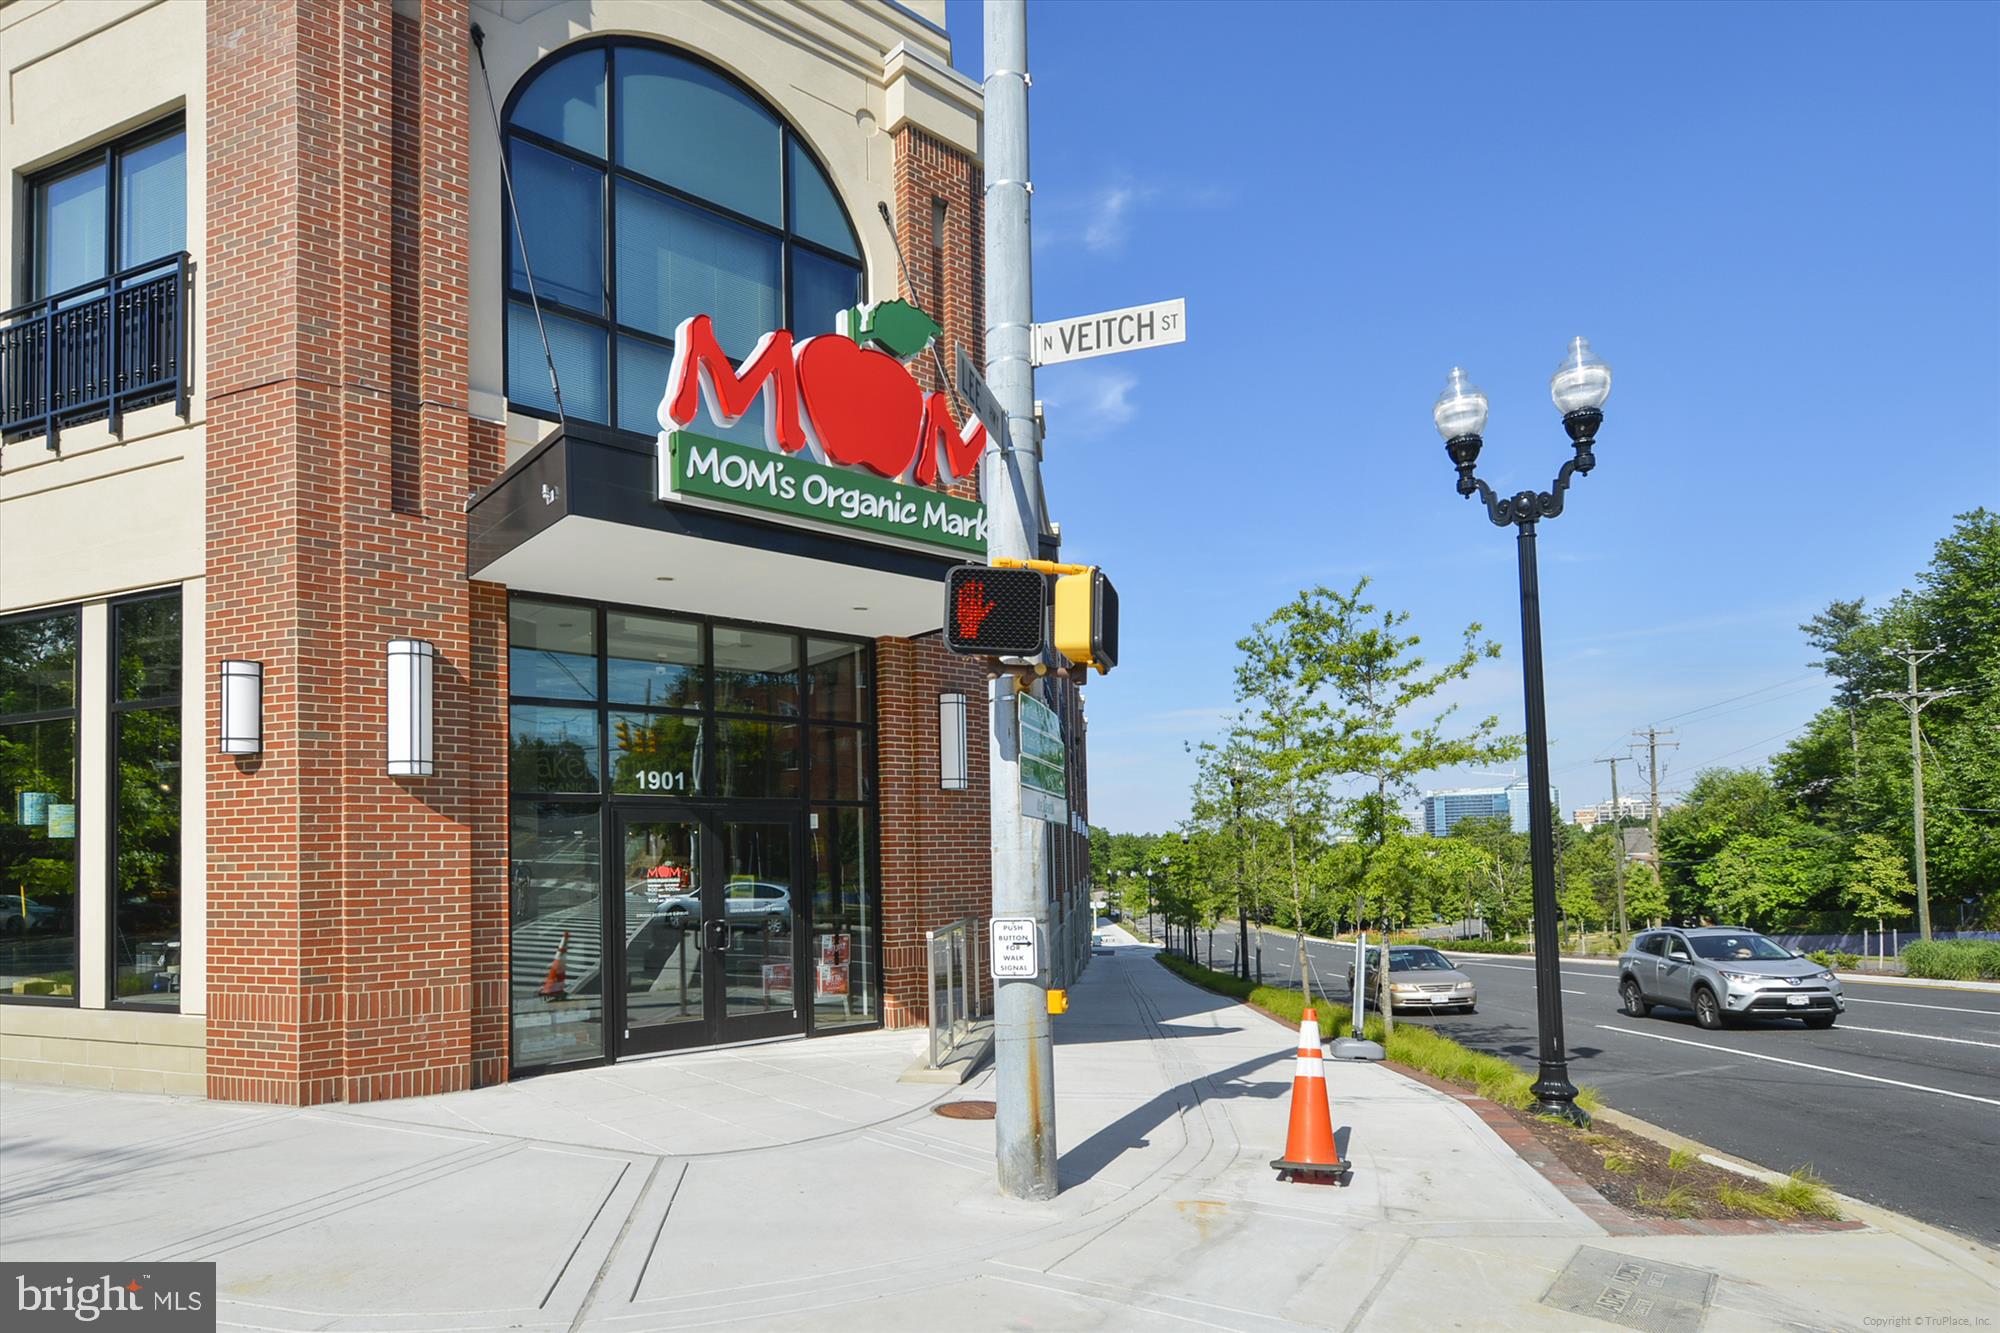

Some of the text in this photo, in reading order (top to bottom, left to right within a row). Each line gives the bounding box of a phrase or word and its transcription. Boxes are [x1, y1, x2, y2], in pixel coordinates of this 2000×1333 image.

[1043, 310, 1179, 354] N VEITCH ST
[961, 357, 982, 415] LEE
[685, 445, 988, 541] MOM's Organic Mark
[635, 769, 685, 791] 1901
